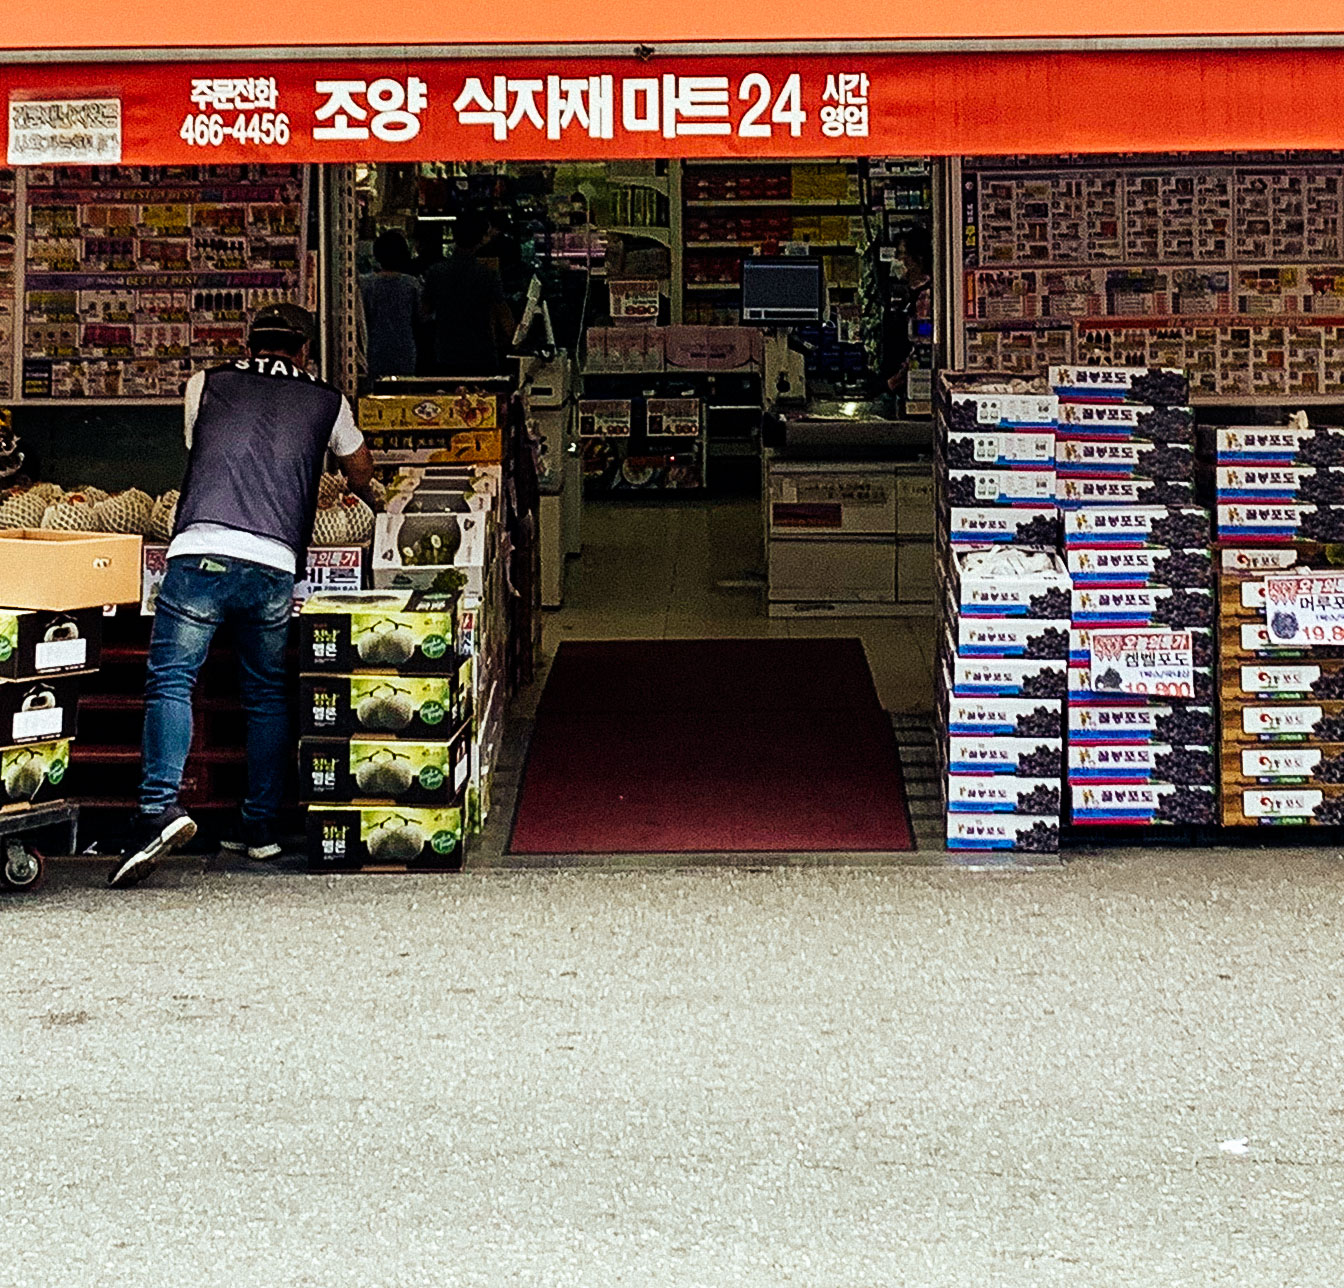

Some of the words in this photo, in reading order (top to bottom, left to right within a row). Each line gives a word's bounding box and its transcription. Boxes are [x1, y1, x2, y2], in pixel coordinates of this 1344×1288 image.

[191, 76, 279, 111] 주문전화
[822, 73, 870, 105] 시간
[314, 77, 426, 142] 조양
[820, 106, 869, 137] 영업
[180, 113, 290, 147] 466-4456
